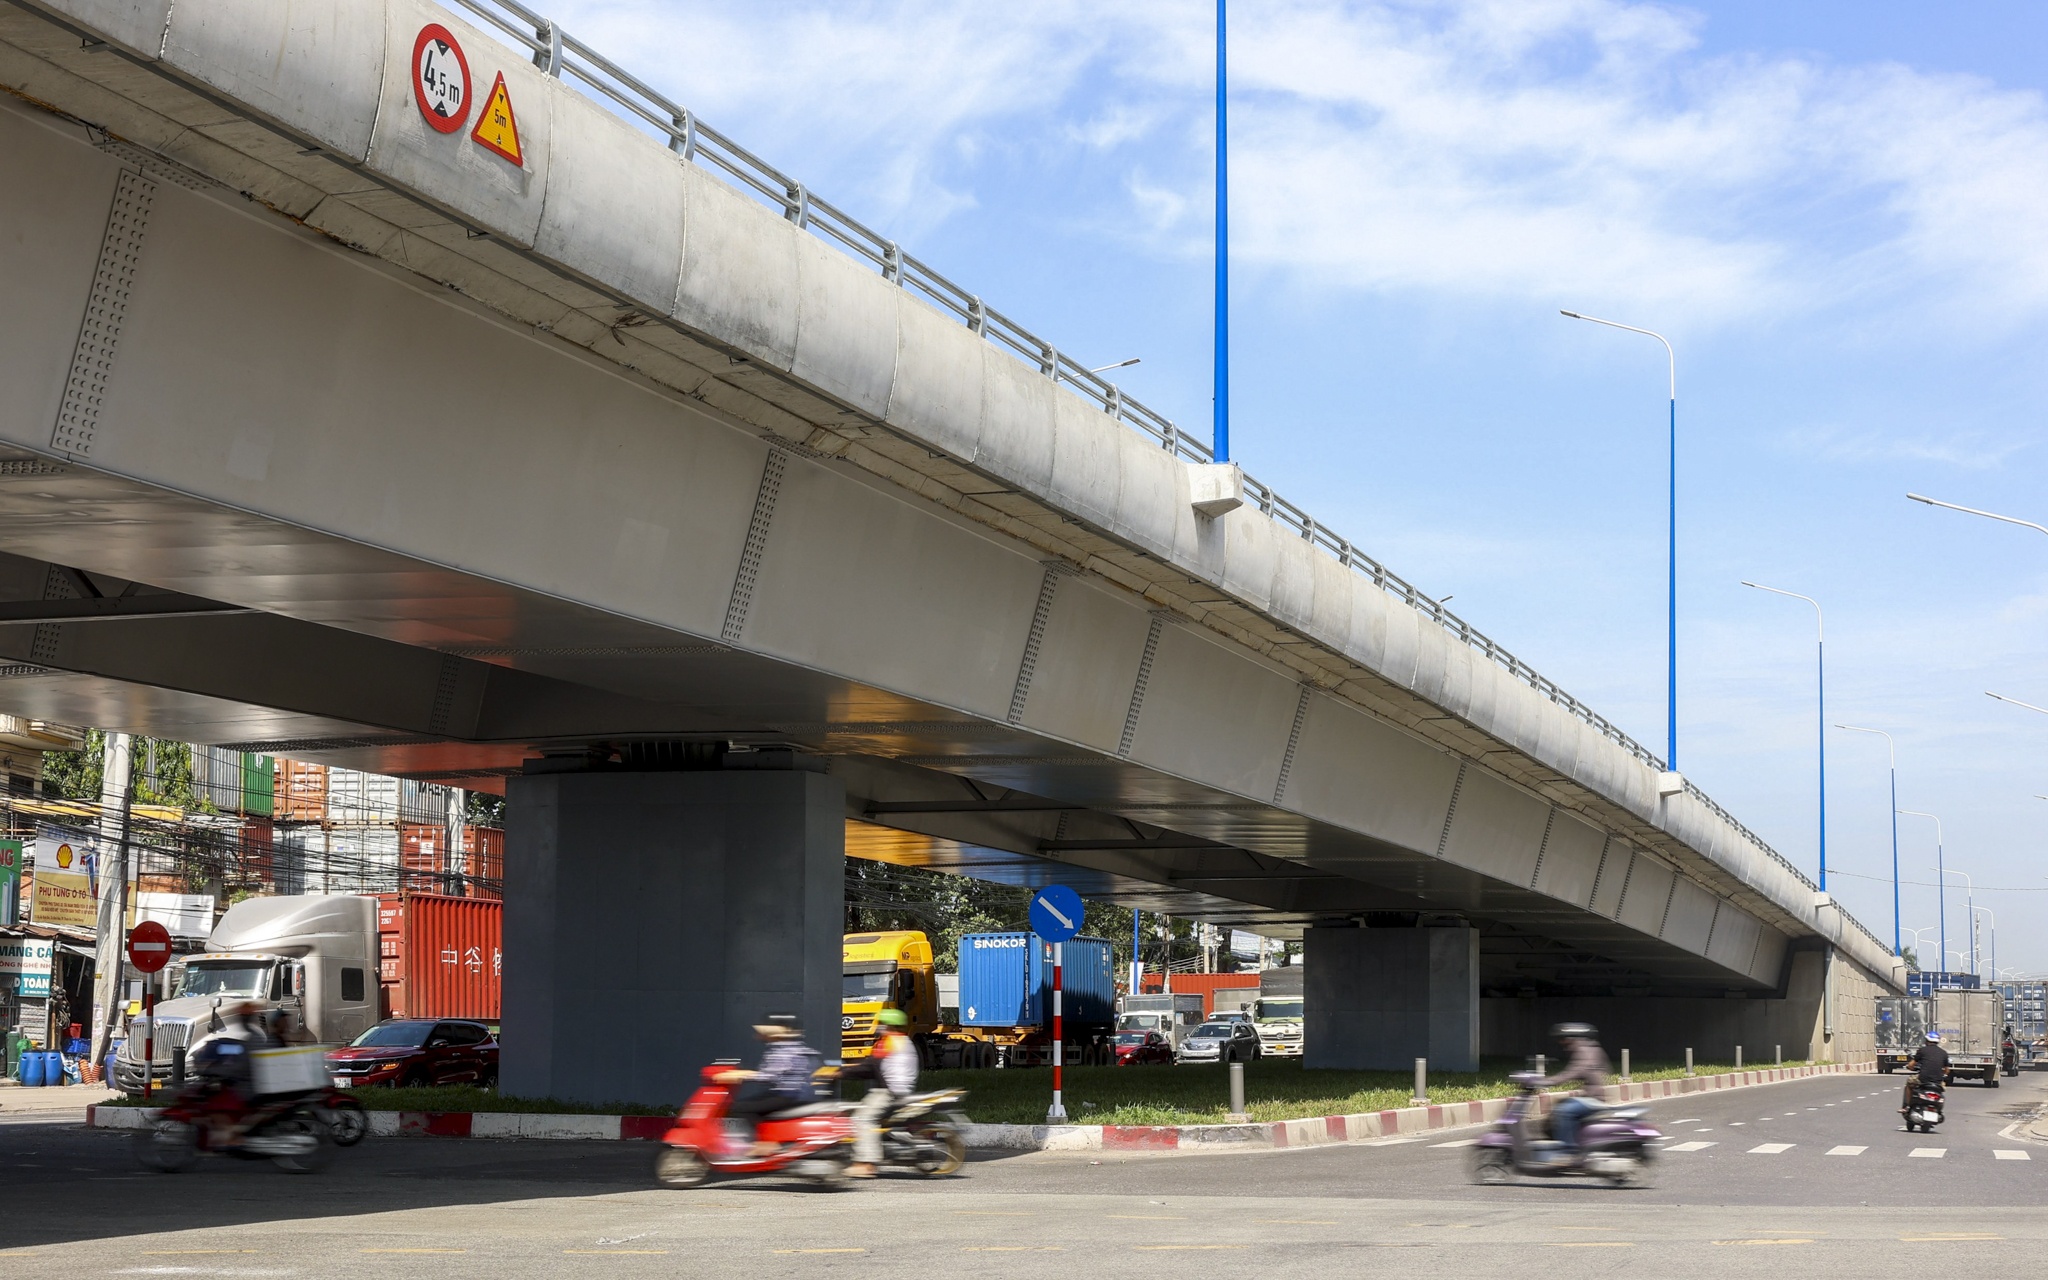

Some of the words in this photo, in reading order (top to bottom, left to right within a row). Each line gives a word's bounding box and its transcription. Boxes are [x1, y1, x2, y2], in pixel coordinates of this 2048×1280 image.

[423, 49, 446, 97] 4,5
[449, 83, 460, 105] m
[494, 108, 507, 129] 5m
[974, 938, 1027, 949] SINOKOR
[23, 975, 49, 990] TOÀN
